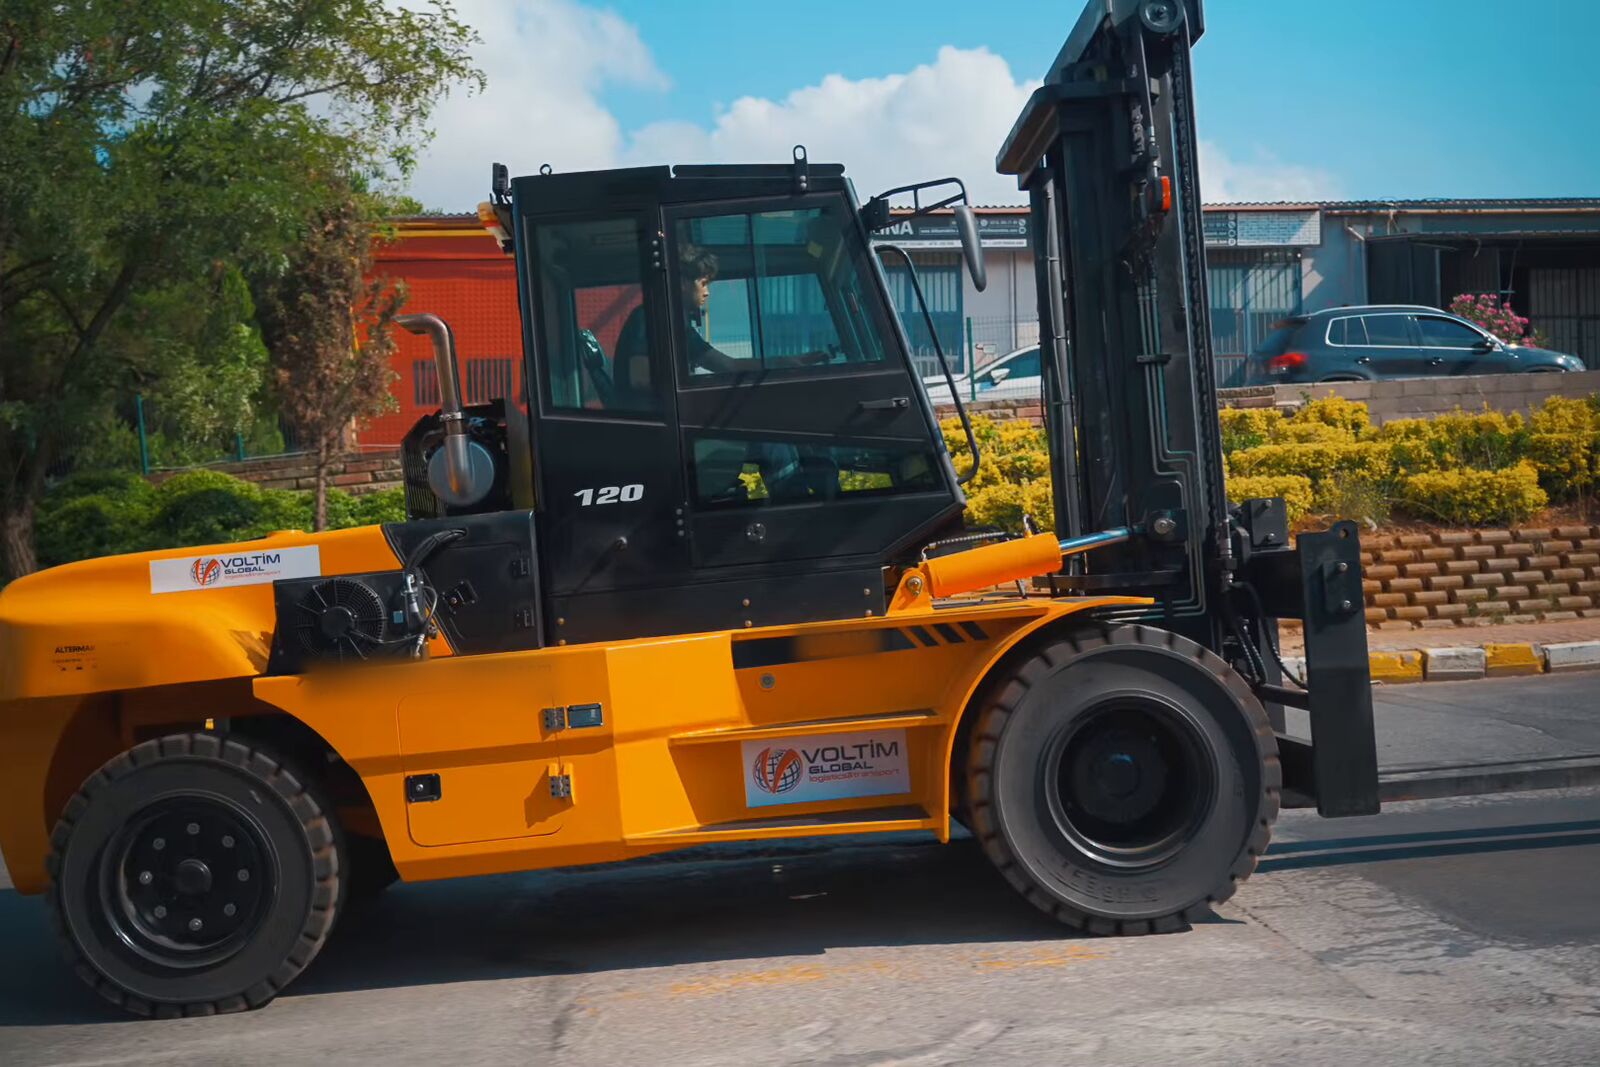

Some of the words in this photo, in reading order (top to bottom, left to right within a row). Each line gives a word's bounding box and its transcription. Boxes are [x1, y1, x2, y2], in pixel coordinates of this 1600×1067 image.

[573, 484, 644, 507] 120
[220, 553, 281, 569] VOLTİM
[224, 566, 265, 575] GLOBAL
[801, 739, 899, 764] VOLTİM
[808, 761, 874, 775] GLOBAL
